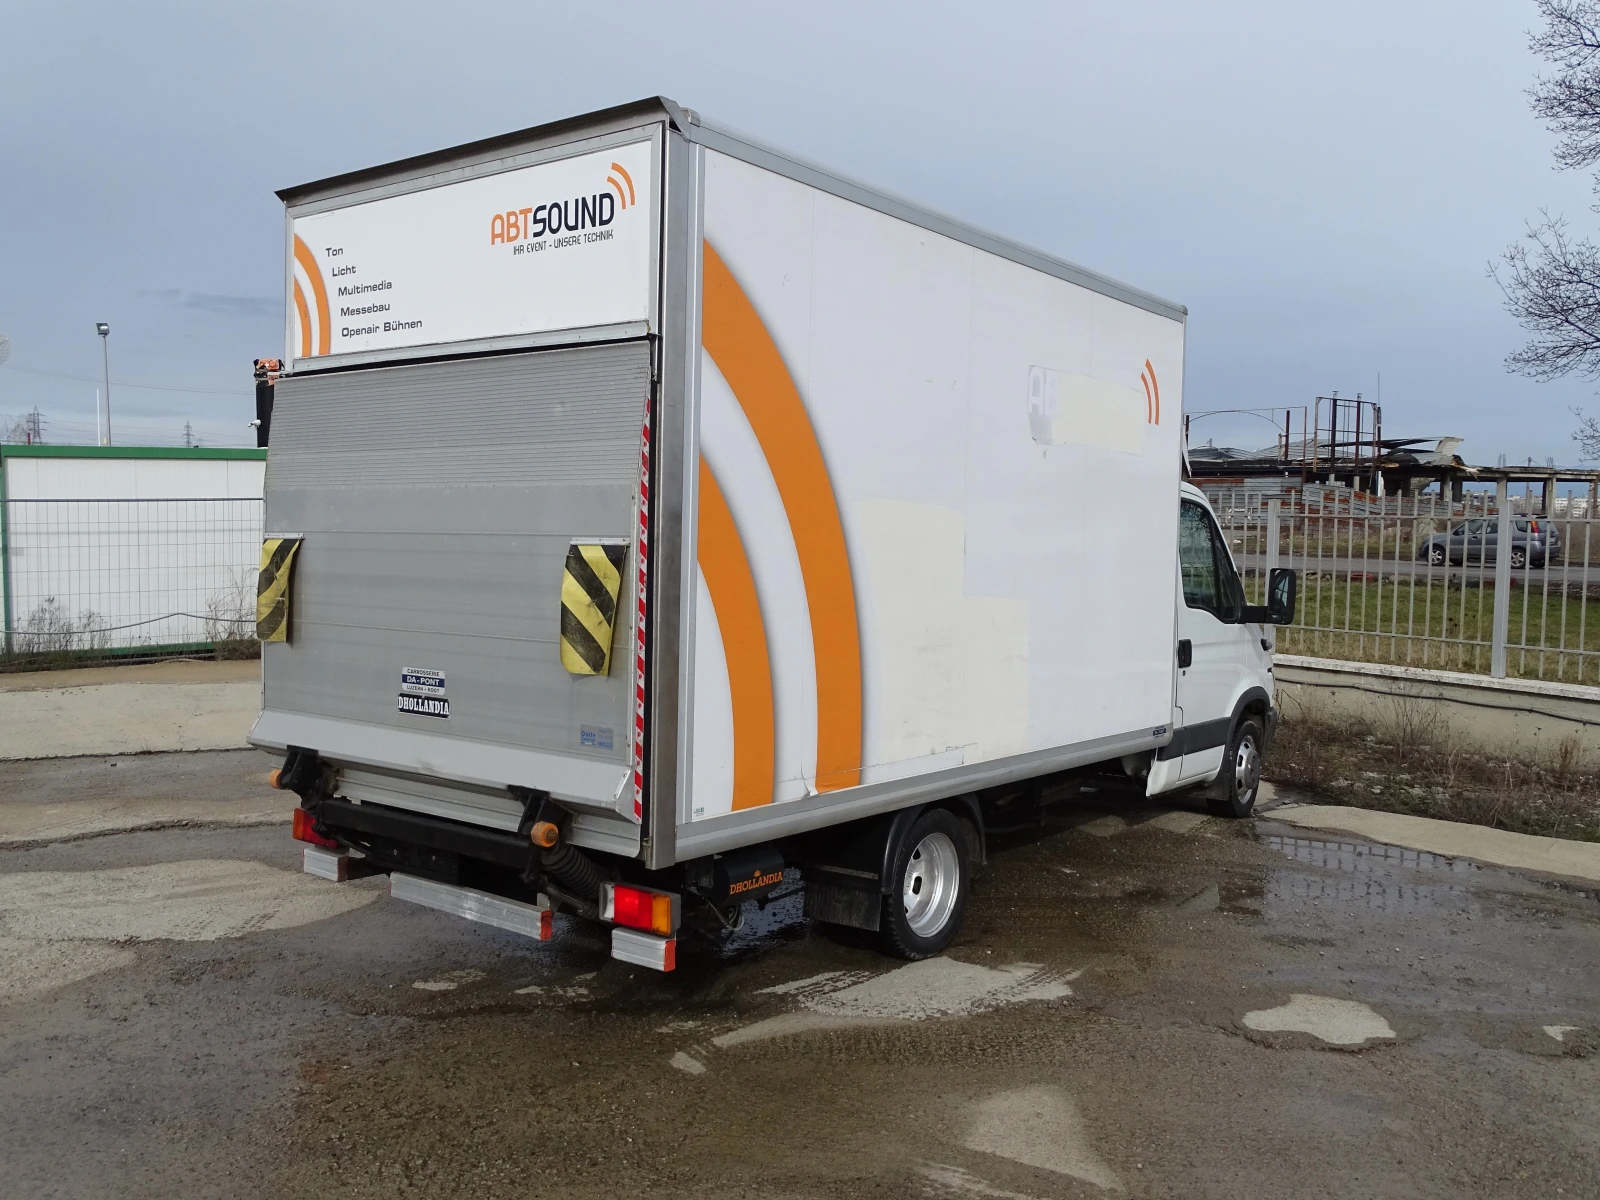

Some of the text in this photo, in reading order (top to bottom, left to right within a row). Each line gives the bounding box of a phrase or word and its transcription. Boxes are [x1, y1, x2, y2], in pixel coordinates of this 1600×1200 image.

[491, 192, 615, 246] ABTSOUND
[513, 244, 525, 256] IHR
[526, 240, 547, 253] EVENT
[553, 234, 581, 249] UNSERE
[583, 229, 614, 244] TECHNIK
[325, 247, 344, 258] Ton
[331, 265, 357, 277] Licht
[338, 280, 393, 297] Multimedia
[340, 303, 391, 317] Messebau
[341, 320, 423, 338] Openair Bühnen
[398, 696, 450, 715] DHOLLANDIA
[730, 871, 783, 895] DHOLLANDIA
